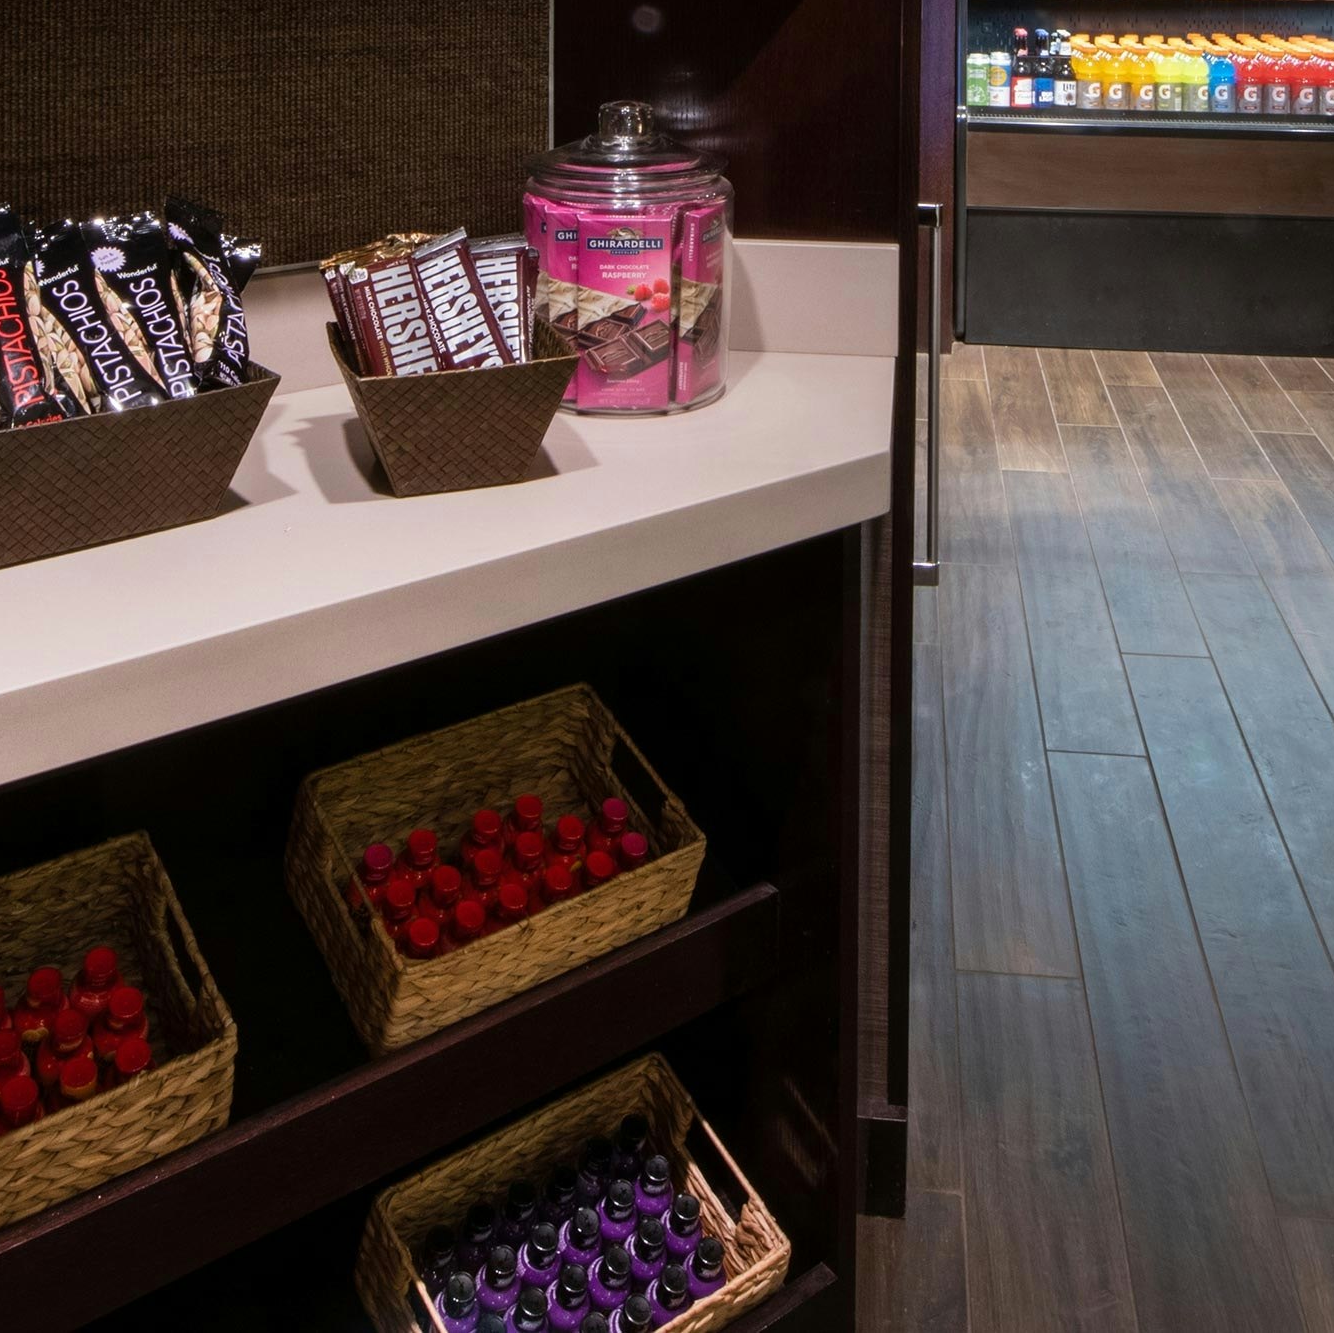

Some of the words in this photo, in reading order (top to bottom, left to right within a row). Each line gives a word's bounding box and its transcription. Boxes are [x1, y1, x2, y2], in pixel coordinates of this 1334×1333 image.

[1109, 85, 1122, 99] G
[1159, 85, 1170, 100] G
[1215, 85, 1228, 100] G
[1244, 87, 1257, 101] G
[1272, 87, 1285, 101] G
[589, 240, 661, 248] GHIRARDELLI
[39, 264, 79, 287] Wonderful
[117, 264, 157, 279] Wonderful
[365, 286, 373, 300] MILK
[368, 300, 383, 340] CHOCOLATE
[52, 280, 142, 402] PISTACHIOS
[130, 278, 192, 397] PISTACHIOS
[427, 313, 446, 354] CHOCOLATE
